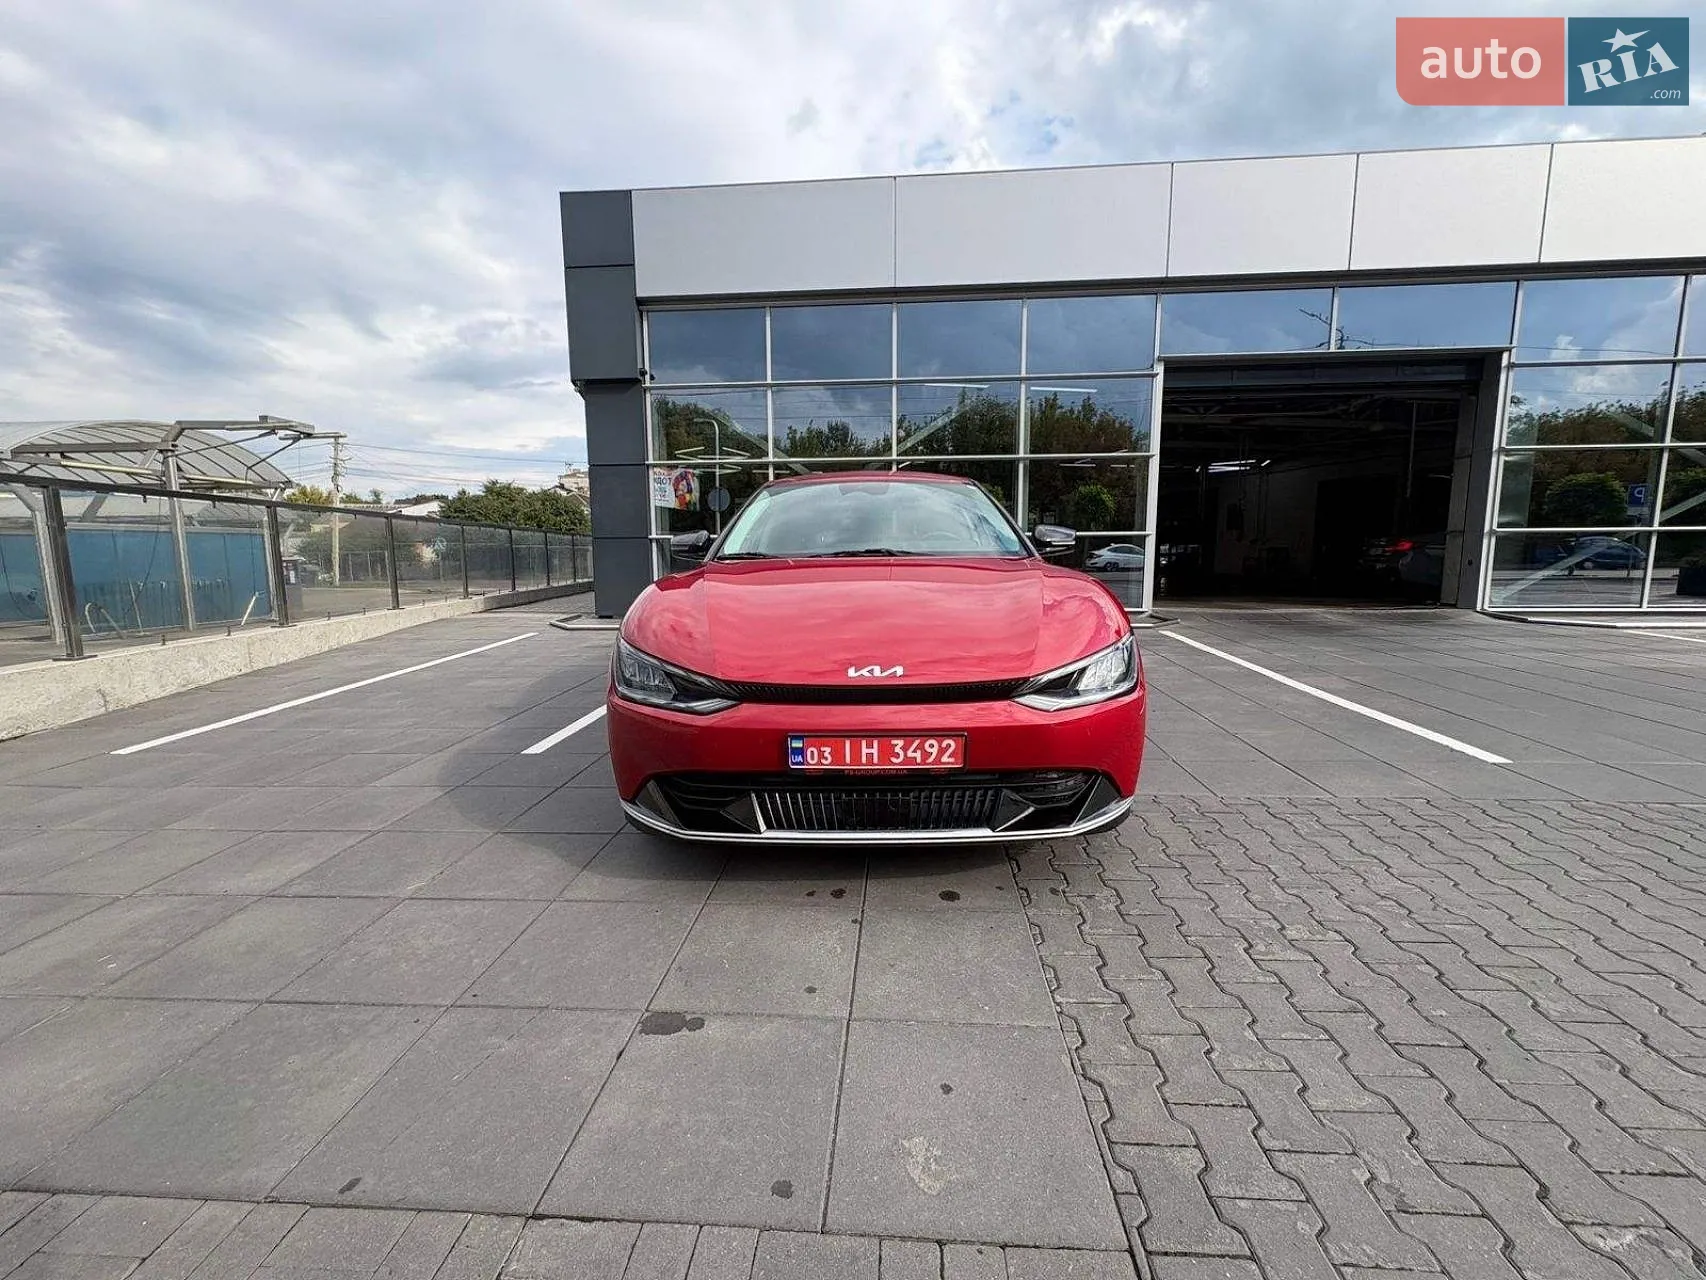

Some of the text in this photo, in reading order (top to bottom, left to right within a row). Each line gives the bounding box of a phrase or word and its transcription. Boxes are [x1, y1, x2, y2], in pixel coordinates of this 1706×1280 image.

[847, 664, 904, 678] KIA
[791, 754, 804, 763] UA
[806, 746, 832, 765] 03
[889, 738, 956, 764] 3492
